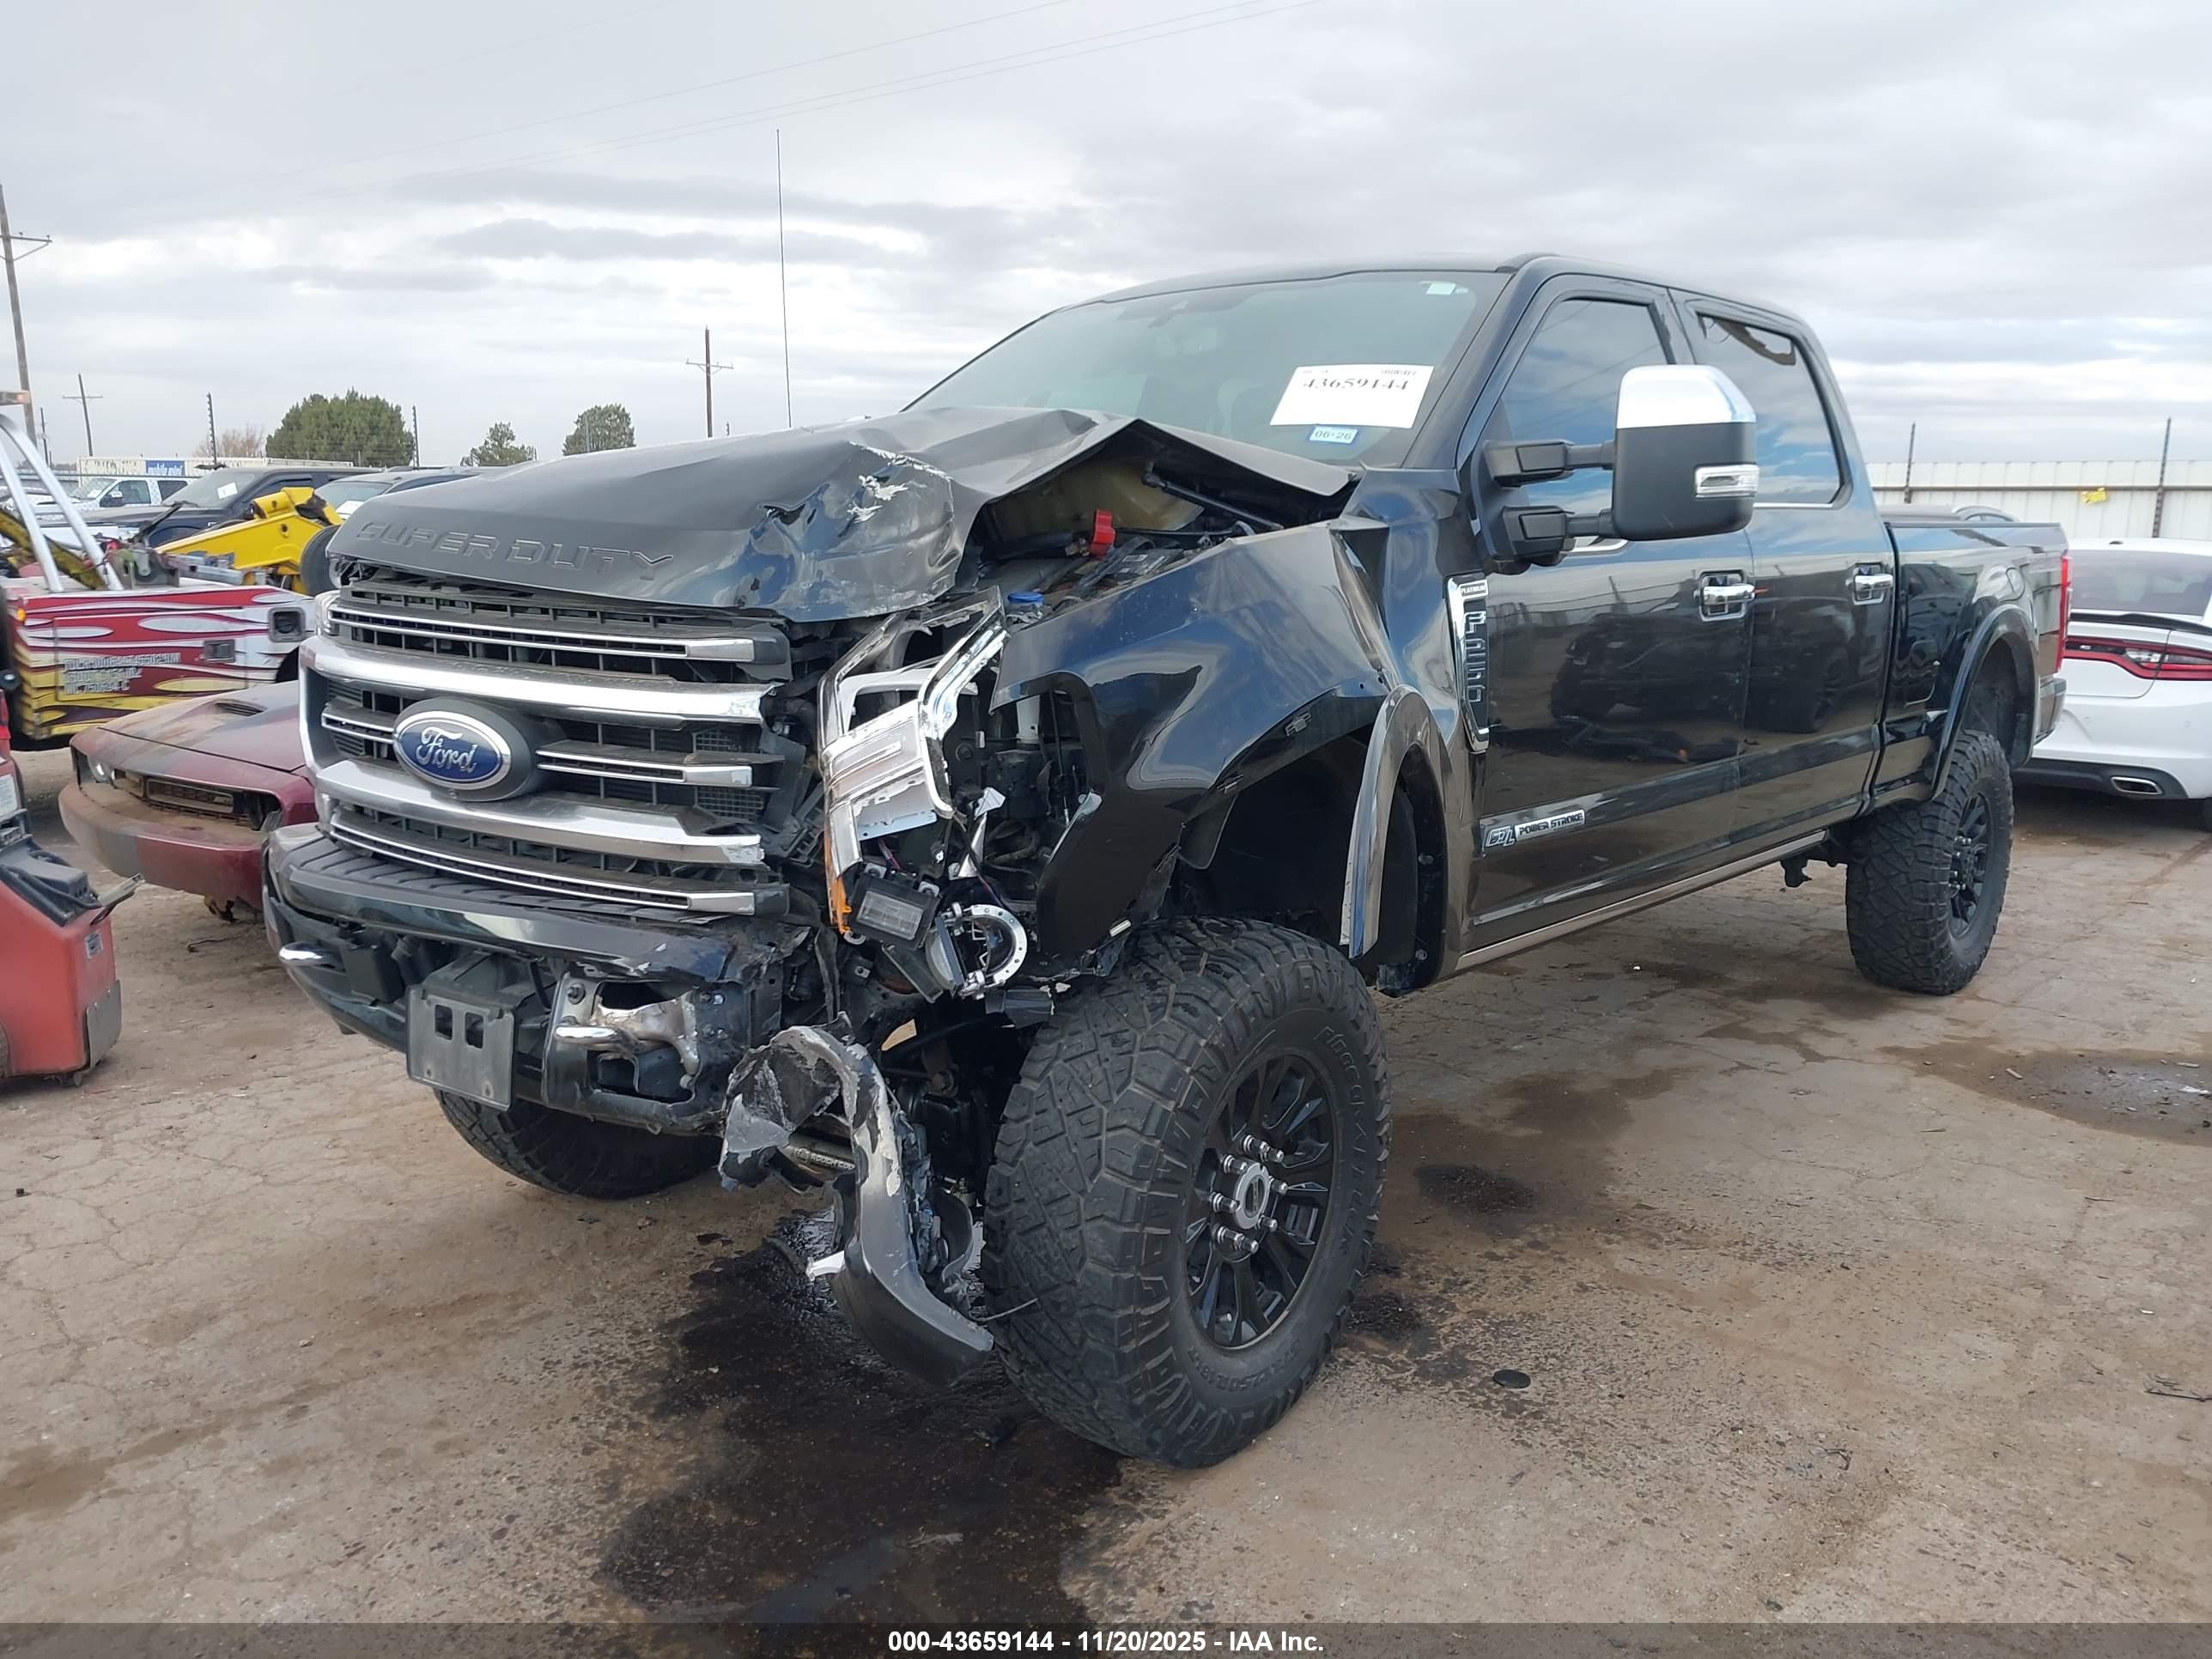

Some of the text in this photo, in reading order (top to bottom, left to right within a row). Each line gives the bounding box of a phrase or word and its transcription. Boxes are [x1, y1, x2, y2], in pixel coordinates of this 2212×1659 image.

[1303, 378, 1408, 390] 43659144
[356, 521, 673, 581] SUPER DUTY
[416, 726, 478, 773] Ford
[1519, 821, 1548, 836] POWER
[1550, 812, 1583, 829] STROKE
